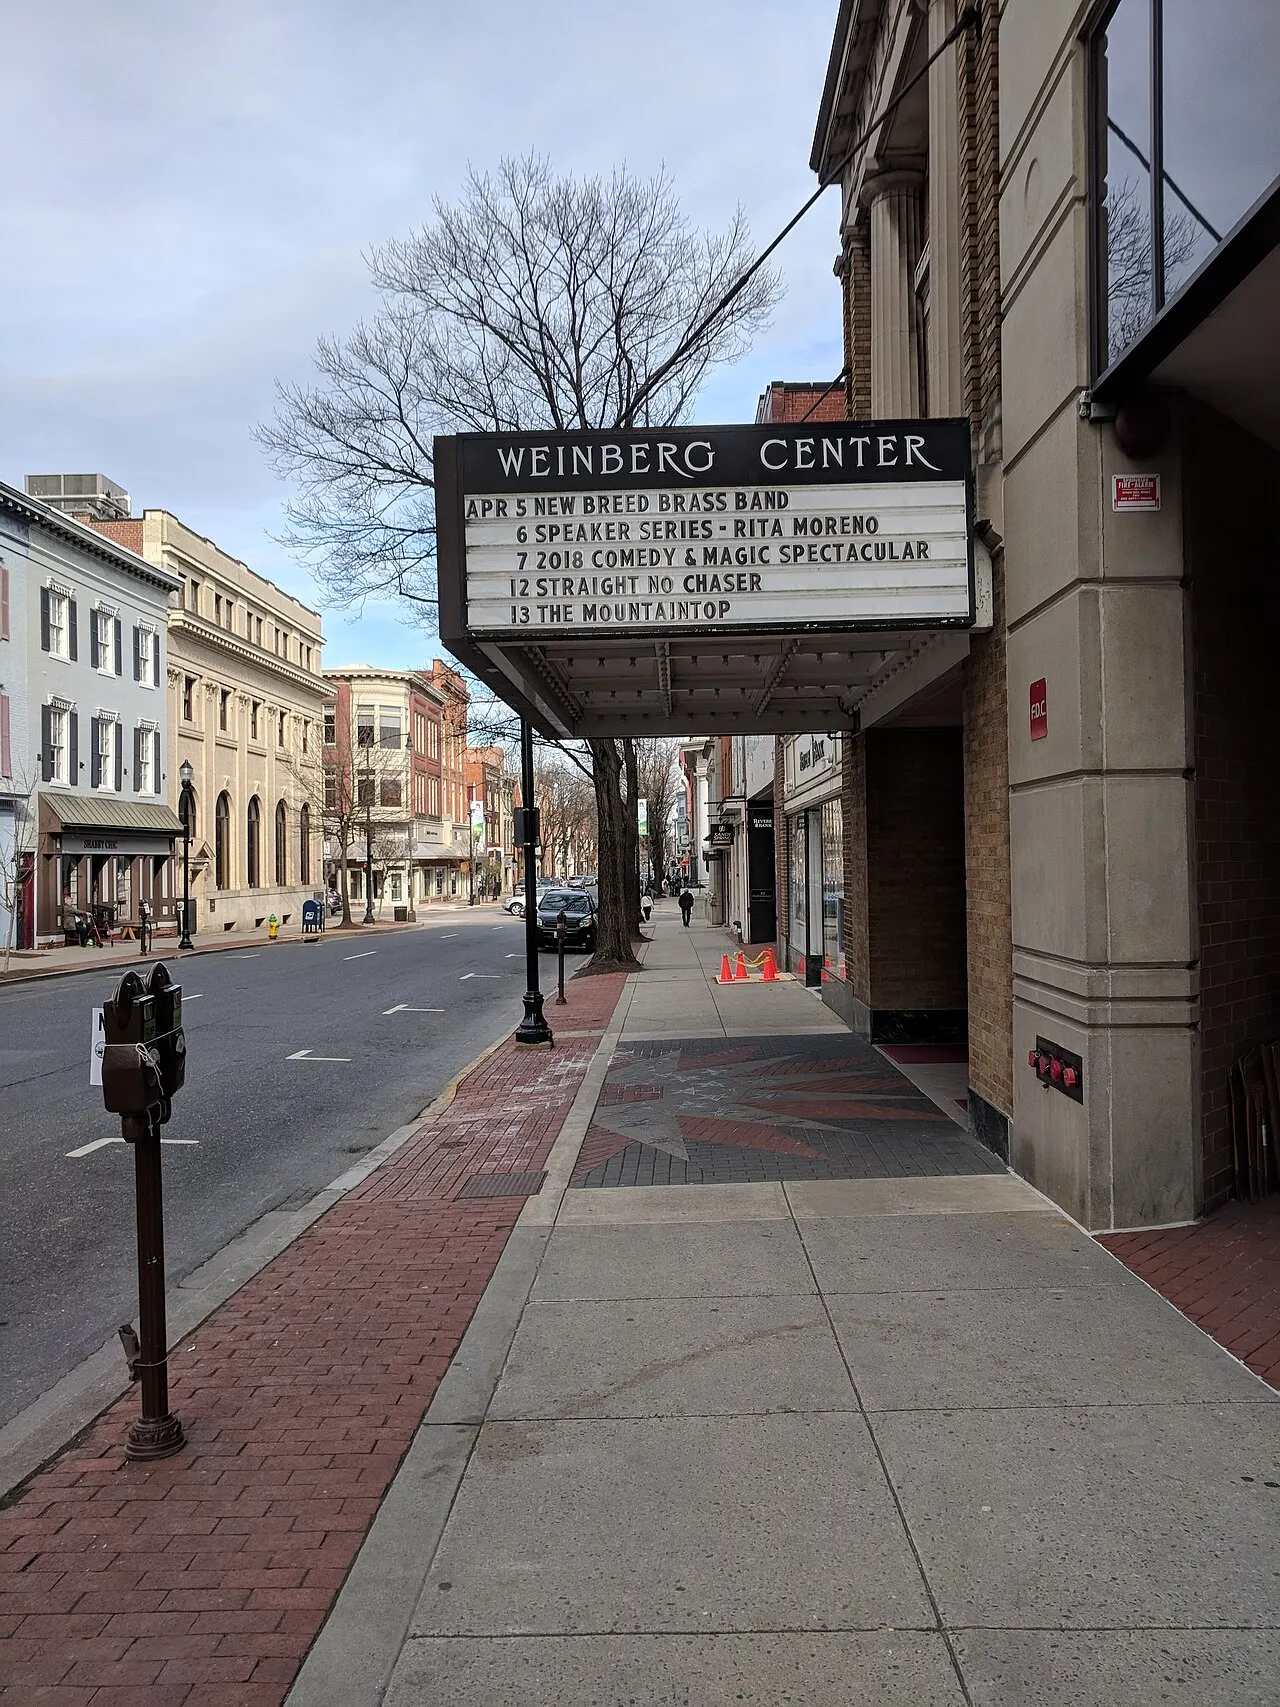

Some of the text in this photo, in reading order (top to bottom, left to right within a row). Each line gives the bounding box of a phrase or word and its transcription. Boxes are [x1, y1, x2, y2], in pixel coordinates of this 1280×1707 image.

[497, 435, 943, 479] WEINBERG CENTER
[466, 490, 789, 518] APR 5 NEW BREED BRASS BAND
[516, 525, 528, 544] 6
[535, 521, 631, 543] SPEAKER
[639, 519, 713, 541] SERIES
[733, 518, 784, 538] RITA
[793, 515, 879, 536] MORENO
[516, 540, 930, 570] 7 2018 COMEDY & MAGIC SPECTACULAR
[510, 572, 763, 597] 12 STRAIGHT NO CHASER
[511, 599, 731, 624] 13 THE MOUNTAINTOP
[105, 840, 119, 850] CHIC
